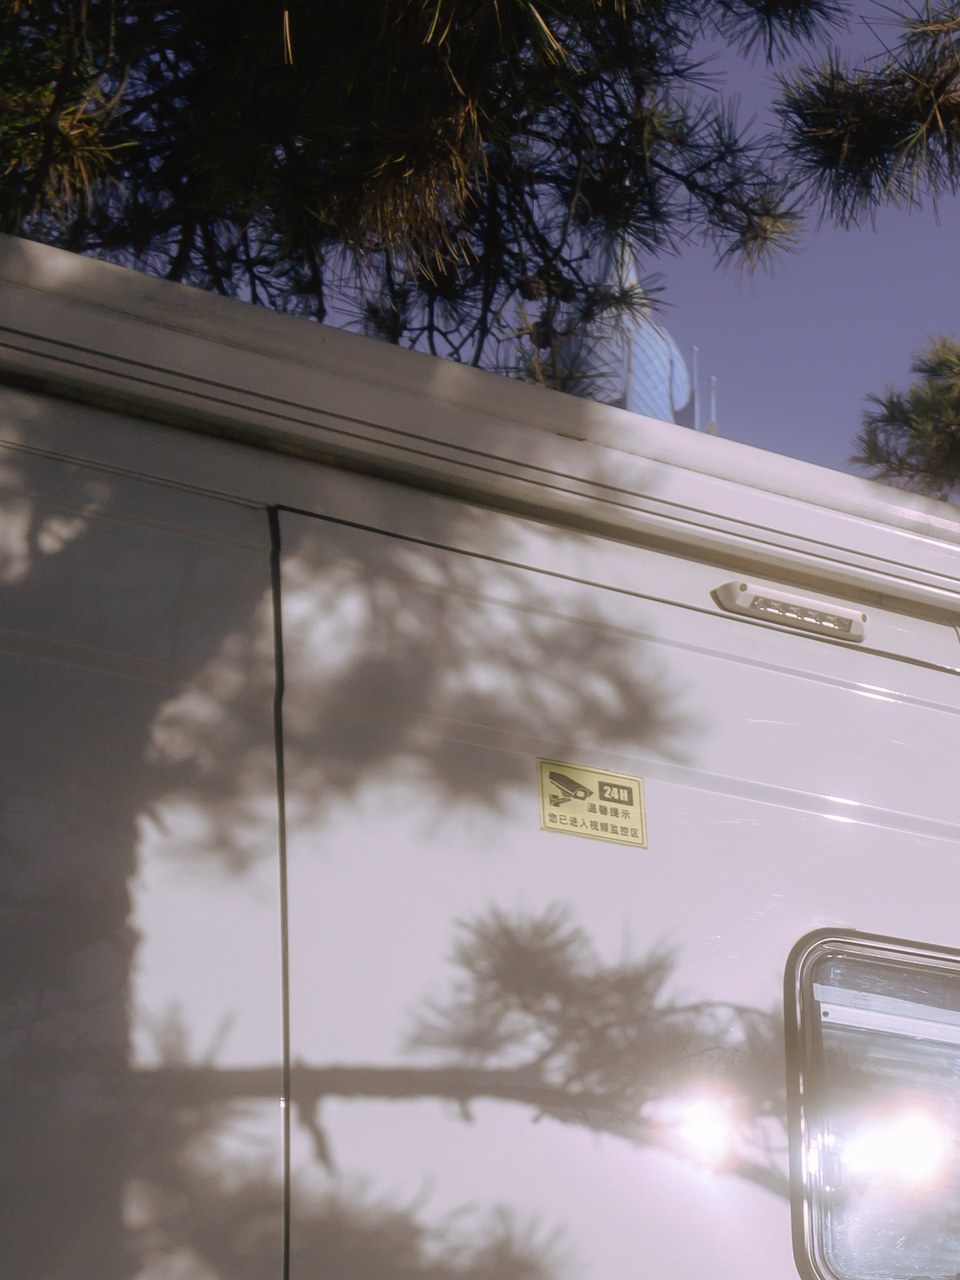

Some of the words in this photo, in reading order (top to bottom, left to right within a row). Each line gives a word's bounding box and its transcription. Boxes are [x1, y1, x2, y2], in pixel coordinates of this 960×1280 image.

[603, 785, 629, 801] 24H
[587, 802, 631, 819] 温馨提示
[548, 812, 639, 838] 您已进入视频监控区
